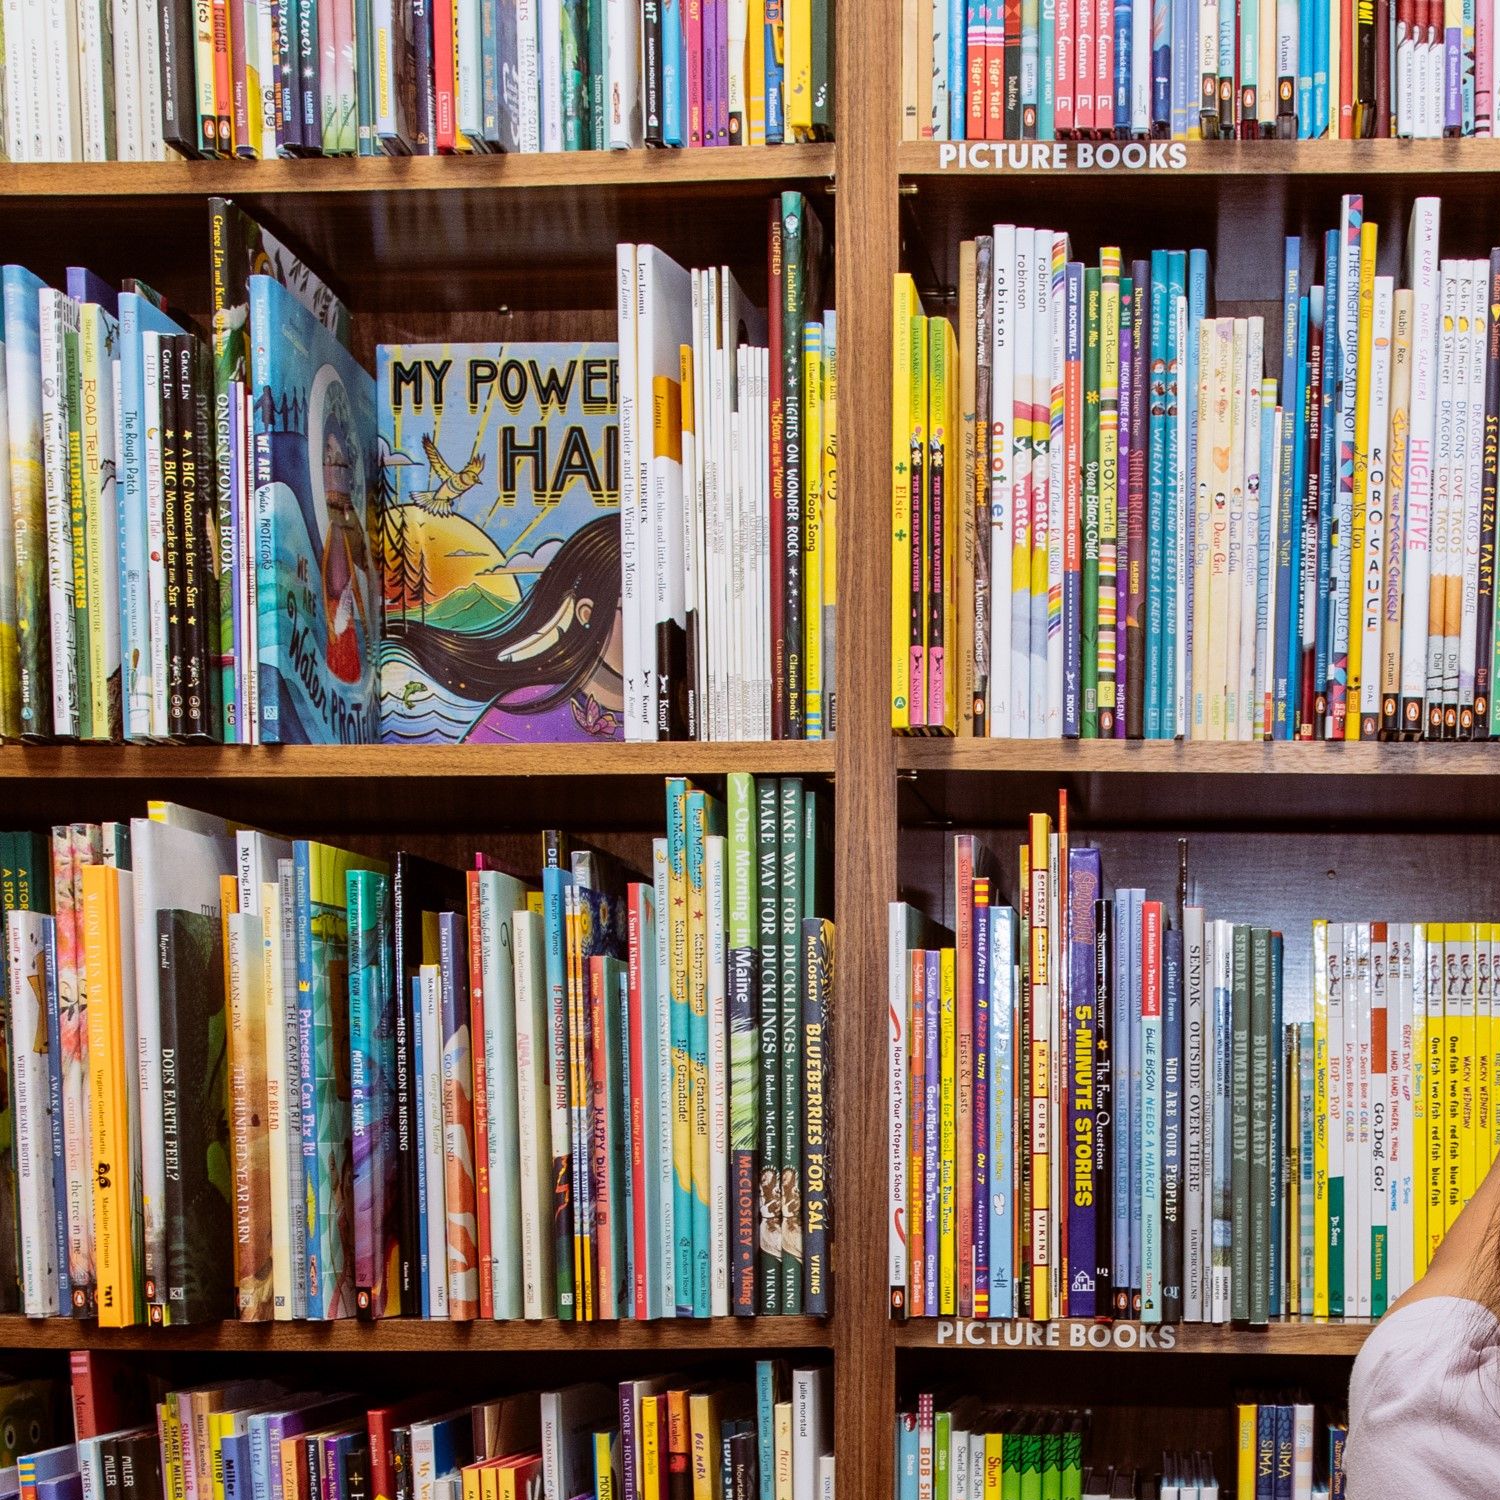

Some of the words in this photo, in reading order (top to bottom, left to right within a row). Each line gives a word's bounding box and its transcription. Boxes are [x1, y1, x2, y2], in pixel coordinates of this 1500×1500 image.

[971, 56, 983, 87] tiger
[971, 89, 982, 119] tales
[940, 143, 1067, 169] PICTURE
[1077, 143, 1187, 169] BOOKS
[997, 268, 1008, 347] robinson
[162, 350, 172, 382] GRACE
[392, 359, 452, 410] MY
[163, 382, 173, 399] LIN
[786, 396, 798, 443] LIGHTS
[164, 448, 174, 456] A
[258, 435, 270, 454] WE
[786, 446, 798, 464] ON
[1484, 415, 1498, 475] SECRET
[164, 461, 177, 488] BIG
[258, 457, 270, 481] ARE
[1410, 439, 1429, 496] HIGH
[786, 467, 799, 522] WONDER
[1481, 486, 1496, 531] PIZZA
[164, 490, 178, 550] Mooncake
[1409, 504, 1429, 550] FIVE
[787, 525, 799, 557] ROCK
[1479, 544, 1494, 596] PARTY
[760, 789, 776, 844] MAKE
[760, 852, 776, 891] WAY
[760, 897, 776, 936] FOR
[1189, 945, 1201, 1007] SENDAK
[760, 945, 777, 1054] DUCKLINGS
[161, 1048, 175, 1085] DOES
[1074, 1005, 1093, 1110] 5-MINUTE
[1165, 1057, 1178, 1083] WHO
[1189, 1021, 1201, 1090] OUTSIDE
[806, 1023, 823, 1146] BLUEBERRIES
[1165, 1091, 1177, 1118] ARE
[163, 1089, 178, 1138] EARTH
[1188, 1095, 1200, 1136] OVER
[1165, 1123, 1177, 1158] YOUR
[165, 1142, 180, 1181] FEEL?
[808, 1153, 823, 1193] FOR
[1074, 1117, 1093, 1208] STORIES
[1188, 1140, 1200, 1193] THERE
[1373, 1165, 1385, 1193] Go!
[1164, 1164, 1177, 1223] PEOPLE?
[808, 1201, 822, 1234] SAL
[937, 1321, 1060, 1346] PICTURE
[1070, 1323, 1176, 1348] BOOKS
